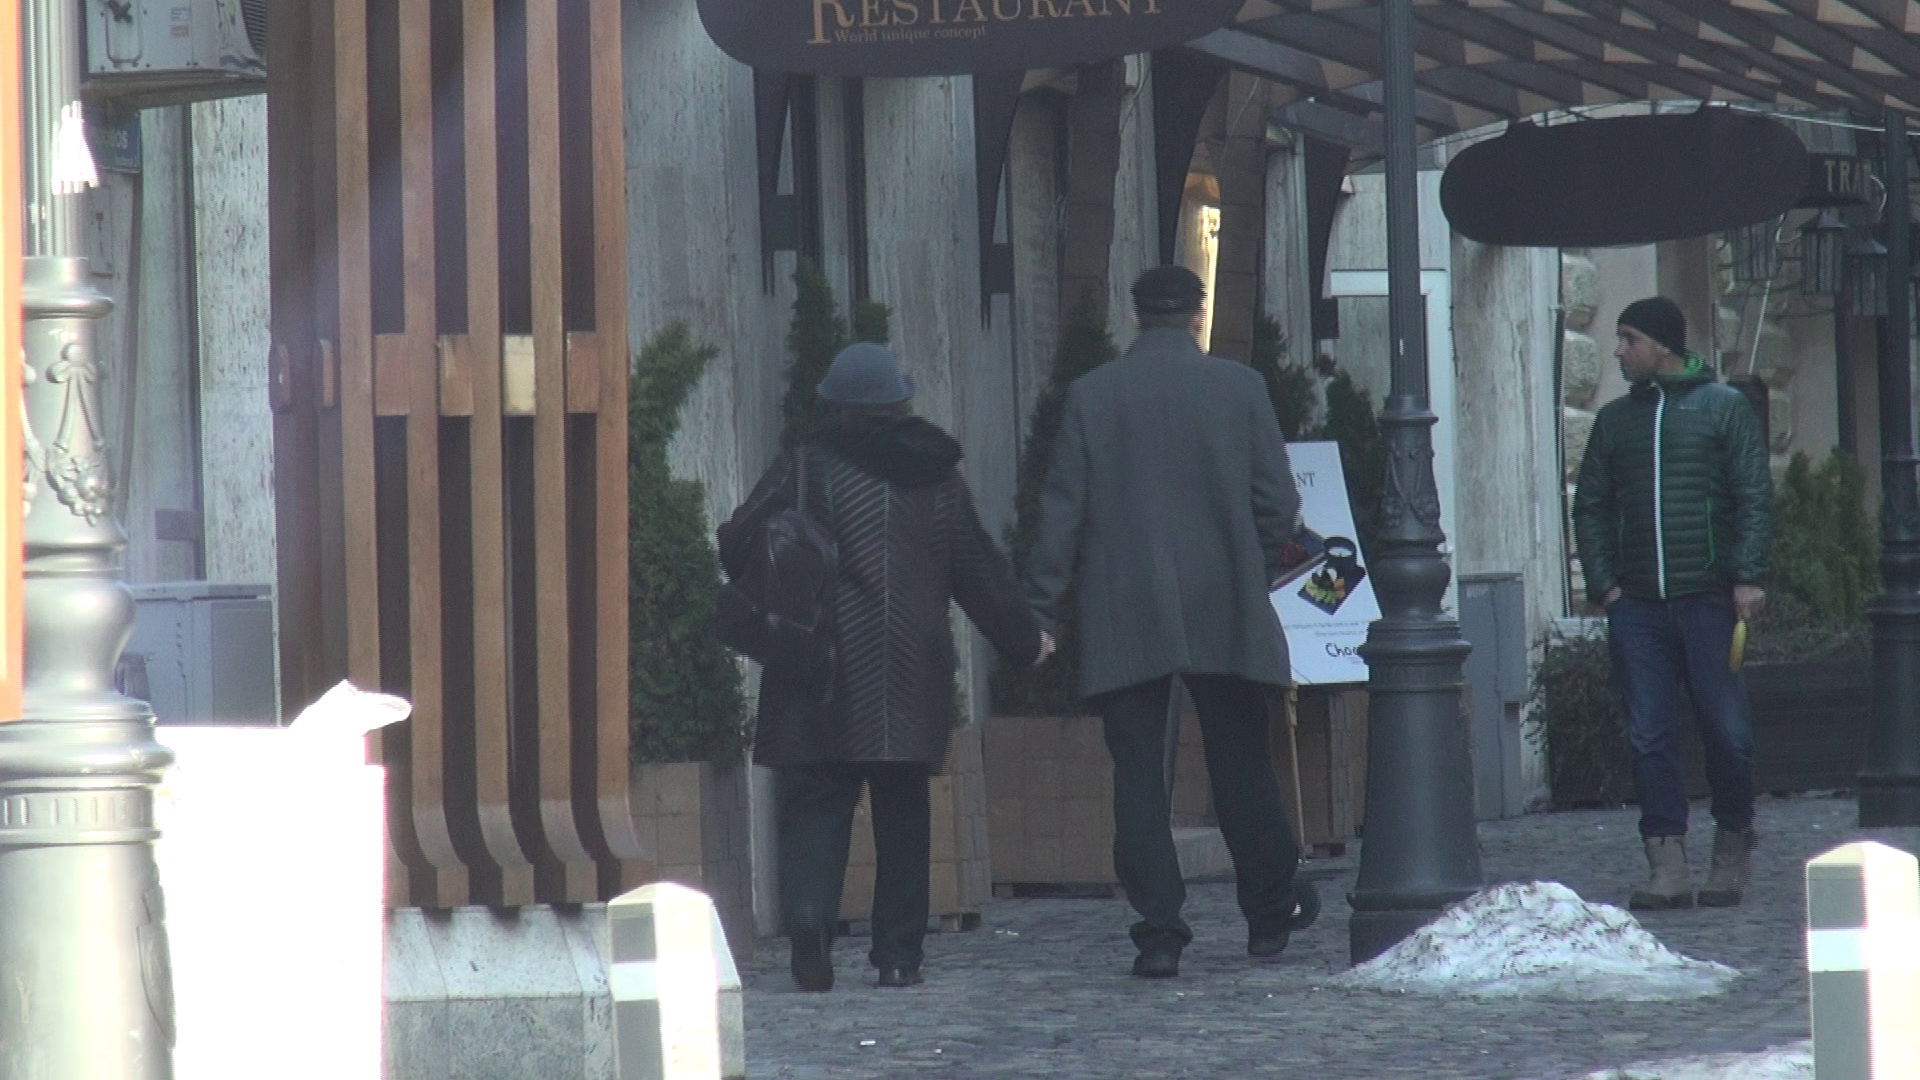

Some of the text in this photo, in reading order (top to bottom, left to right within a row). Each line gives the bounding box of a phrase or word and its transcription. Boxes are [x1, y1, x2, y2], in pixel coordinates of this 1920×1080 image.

[834, 25, 986, 45] World unique concept
